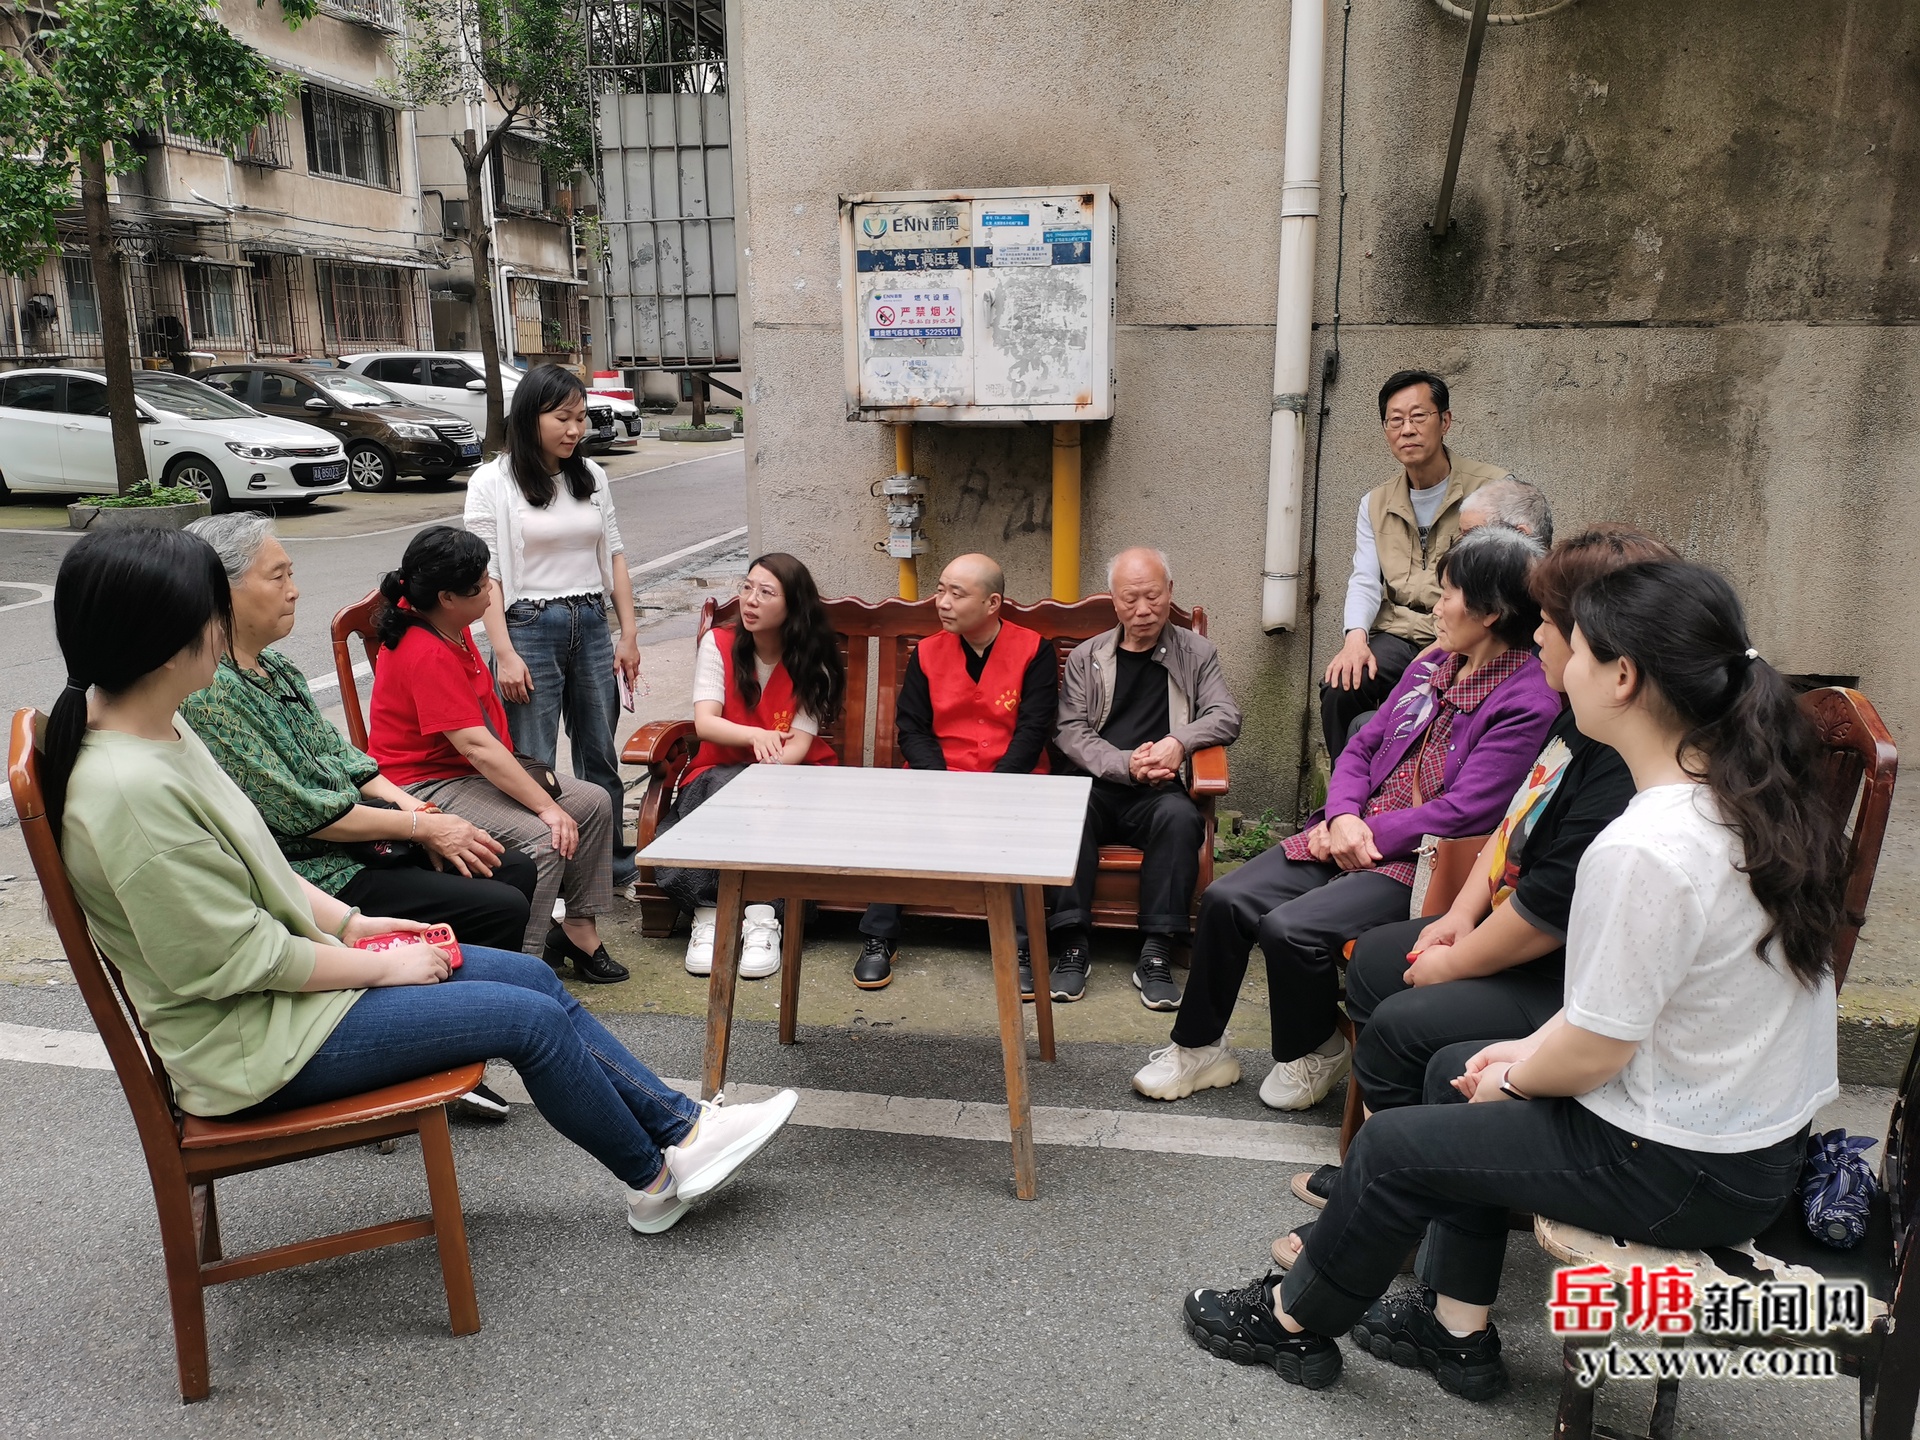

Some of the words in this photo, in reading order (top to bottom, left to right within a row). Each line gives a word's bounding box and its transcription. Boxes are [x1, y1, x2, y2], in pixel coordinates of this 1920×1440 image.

[893, 216, 959, 233] ENN新奥
[893, 252, 959, 268] 燃气调压器
[901, 306, 955, 317] 严禁烟火
